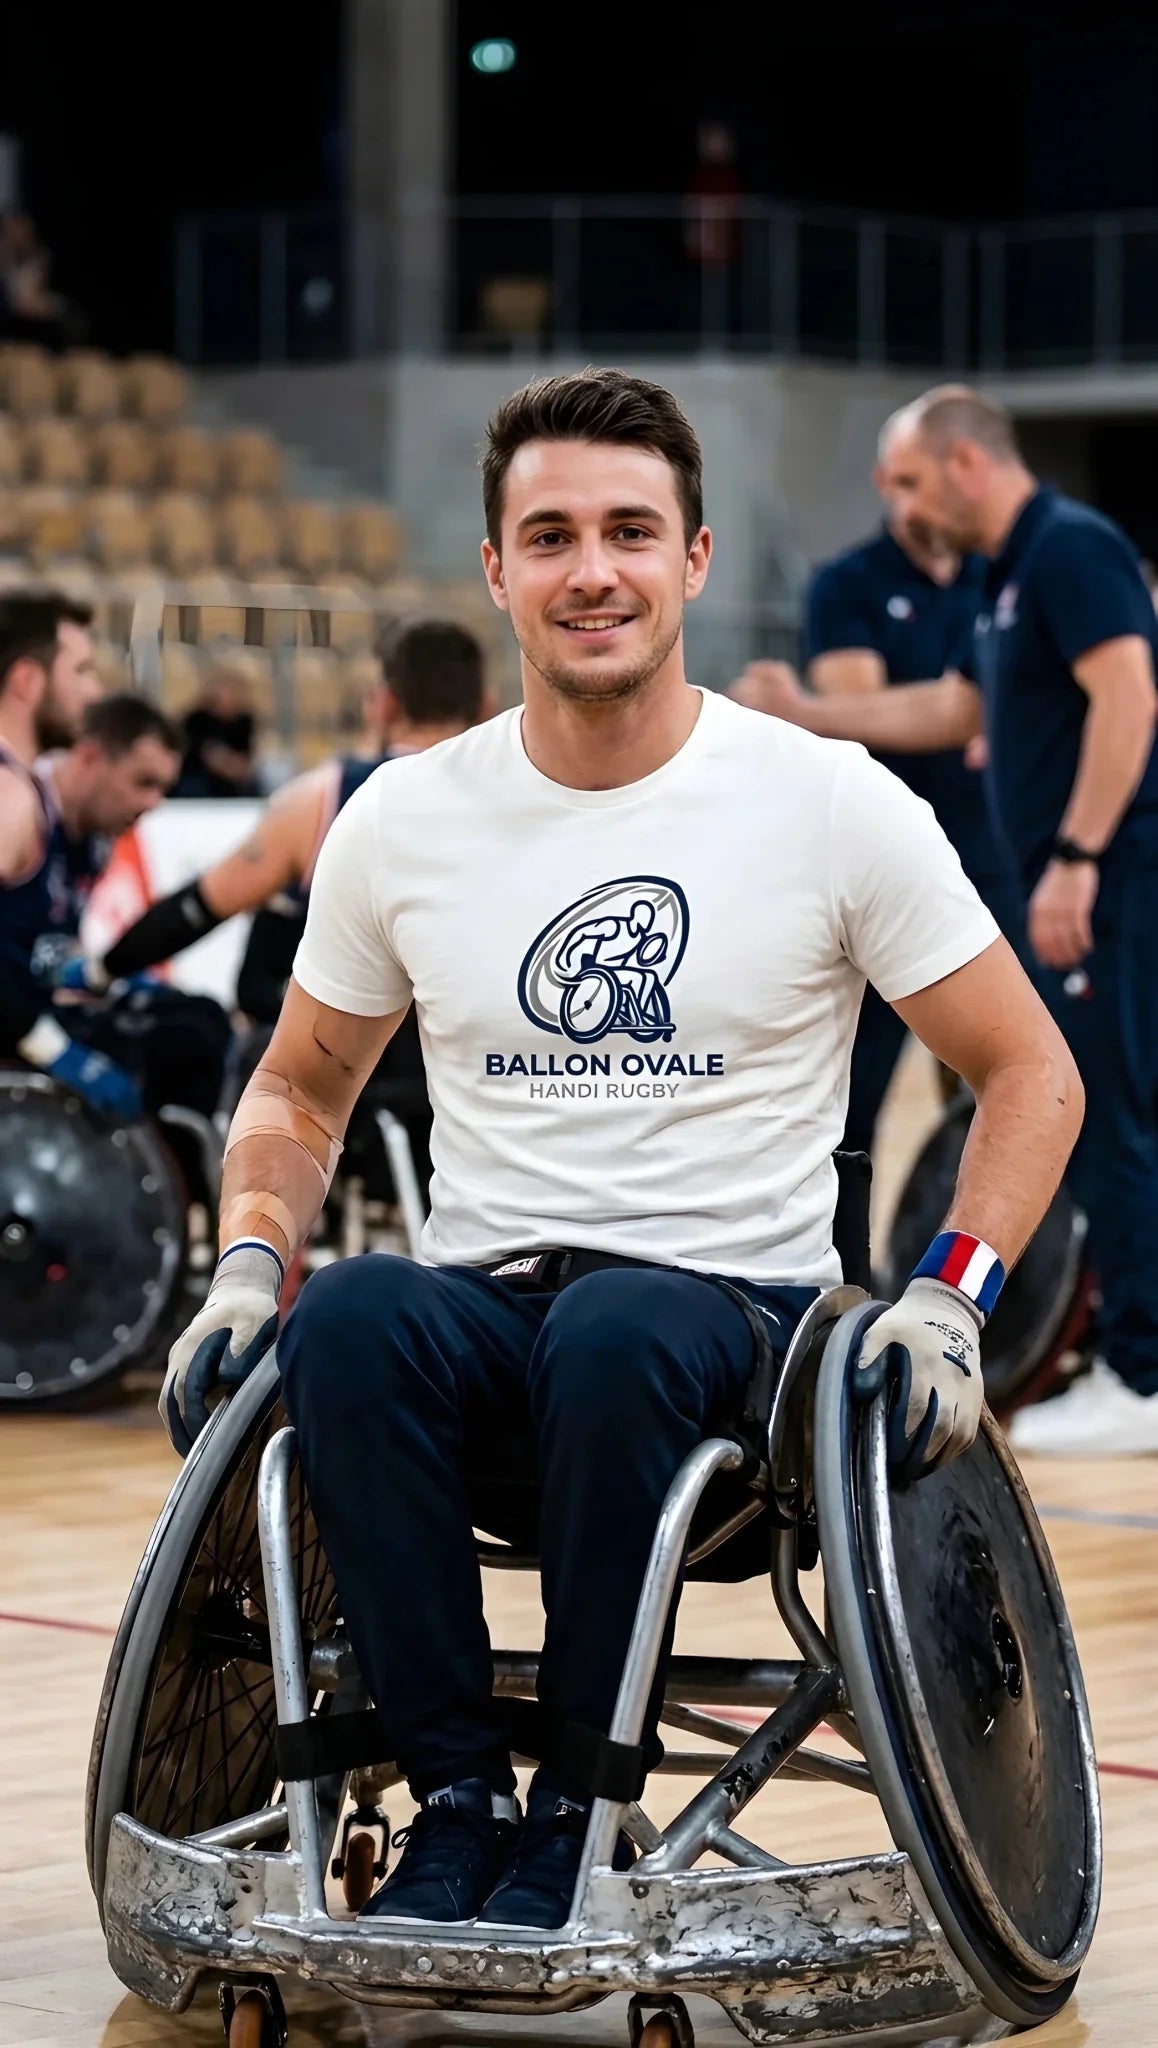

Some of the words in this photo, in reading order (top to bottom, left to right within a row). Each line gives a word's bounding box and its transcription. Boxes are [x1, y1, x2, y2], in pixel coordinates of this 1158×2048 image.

[486, 1053, 609, 1076] BALLON
[621, 1053, 724, 1076] OVALE
[530, 1083, 598, 1099] HANDI
[606, 1083, 680, 1099] RUGBY
